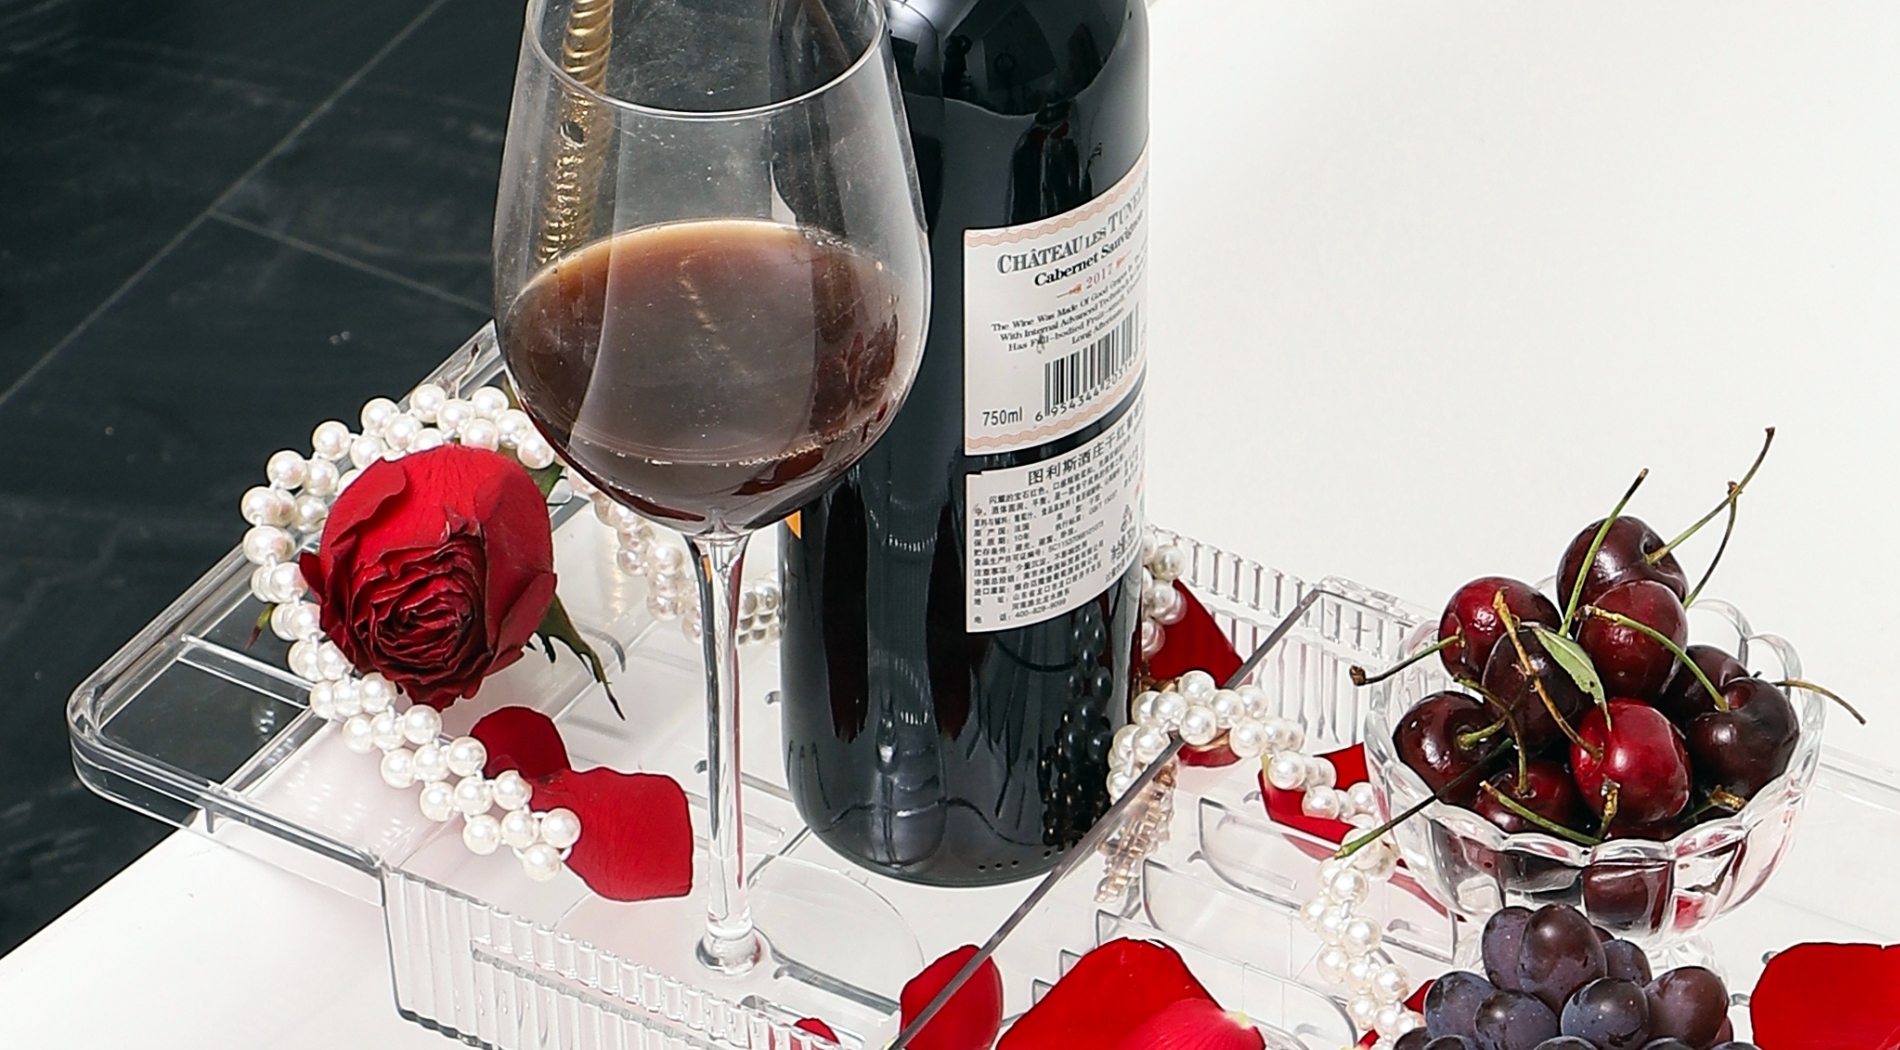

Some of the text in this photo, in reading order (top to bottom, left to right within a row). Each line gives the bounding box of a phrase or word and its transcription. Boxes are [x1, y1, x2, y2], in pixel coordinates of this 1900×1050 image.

[997, 236, 1083, 274] CHÂTEAU
[1086, 228, 1107, 249] LES
[1035, 252, 1099, 286] Cabernet
[1086, 263, 1113, 289] 2017
[991, 322, 1009, 332] The
[1012, 318, 1034, 328] Wine
[1037, 313, 1055, 323] Was
[1057, 303, 1078, 317] Made
[1080, 296, 1090, 308] Of
[1091, 286, 1108, 302] Good
[1000, 328, 1022, 341] With
[1024, 319, 1058, 337] Internal
[1060, 303, 1098, 327] Advanced
[1008, 341, 1027, 351] Has
[1071, 331, 1091, 345] Long
[982, 406, 1023, 427] 750ml
